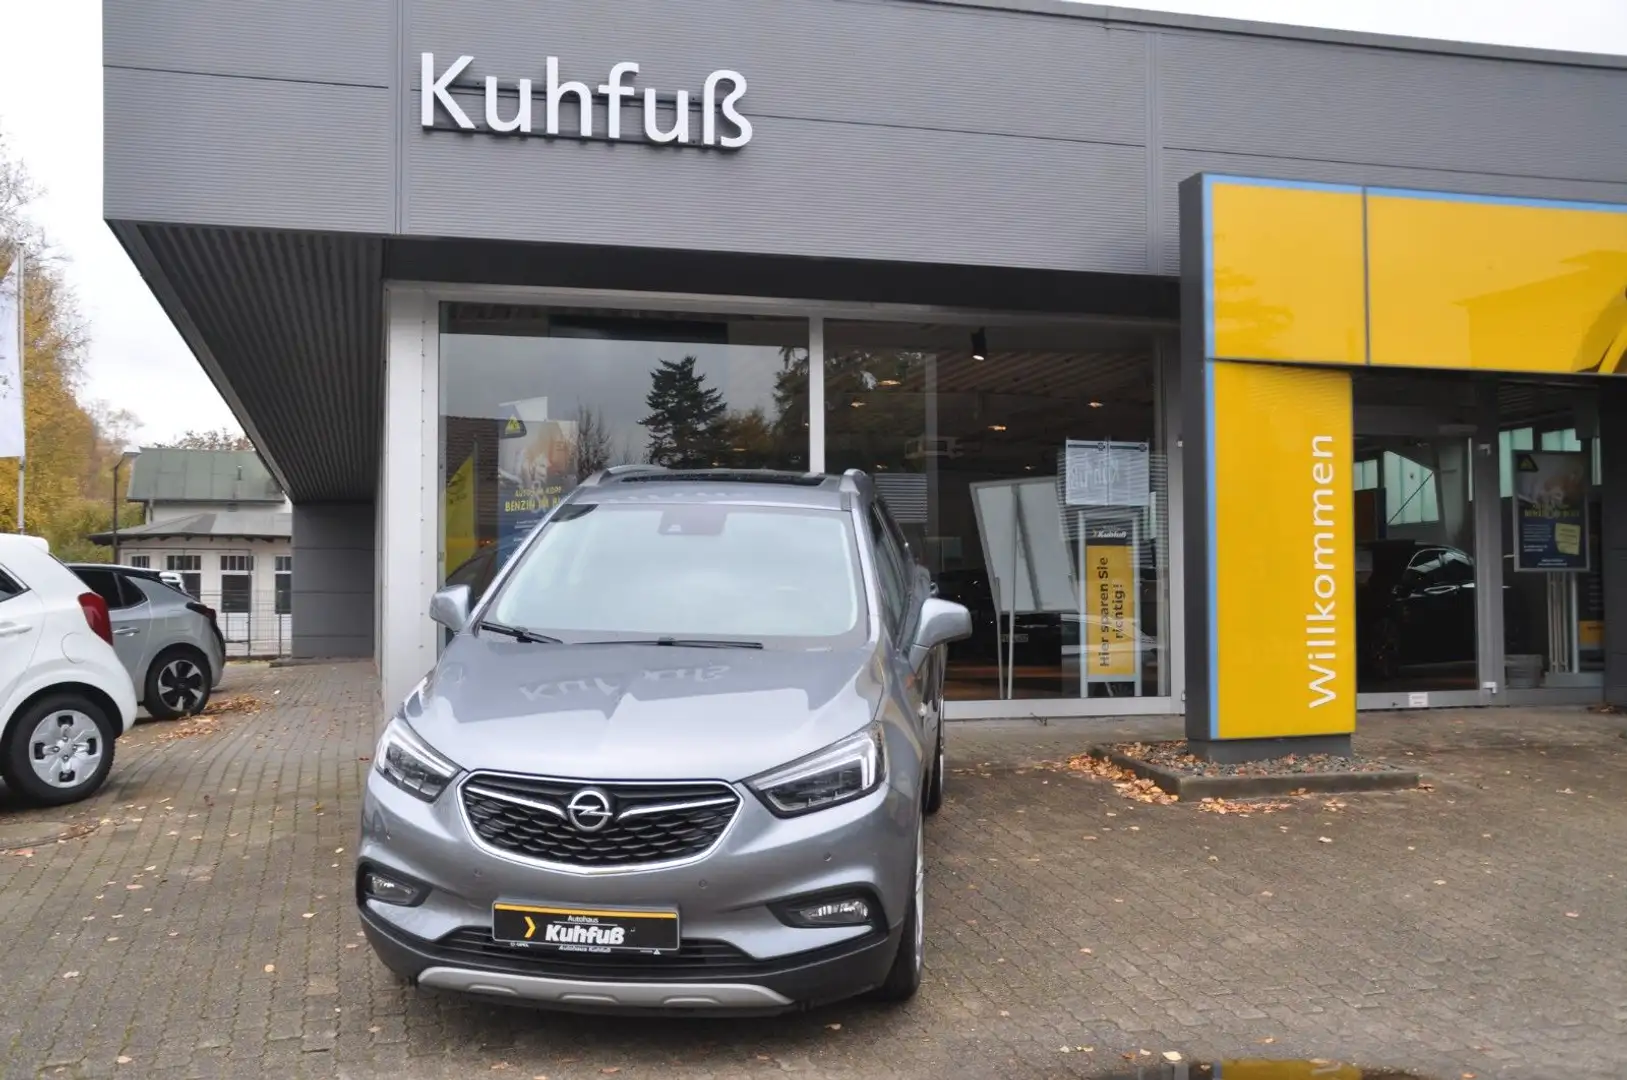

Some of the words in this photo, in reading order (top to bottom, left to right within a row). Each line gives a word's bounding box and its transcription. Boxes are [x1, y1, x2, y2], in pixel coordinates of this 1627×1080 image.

[421, 52, 753, 148] Kuhfuß
[505, 499, 536, 512] BENZIN
[1097, 557, 1109, 579] Sie
[1306, 435, 1337, 708] Willkommen
[1100, 583, 1112, 633] sparen
[1099, 637, 1110, 667] Hier
[567, 915, 599, 923] Autohaus
[545, 924, 625, 944] Kuhfuß
